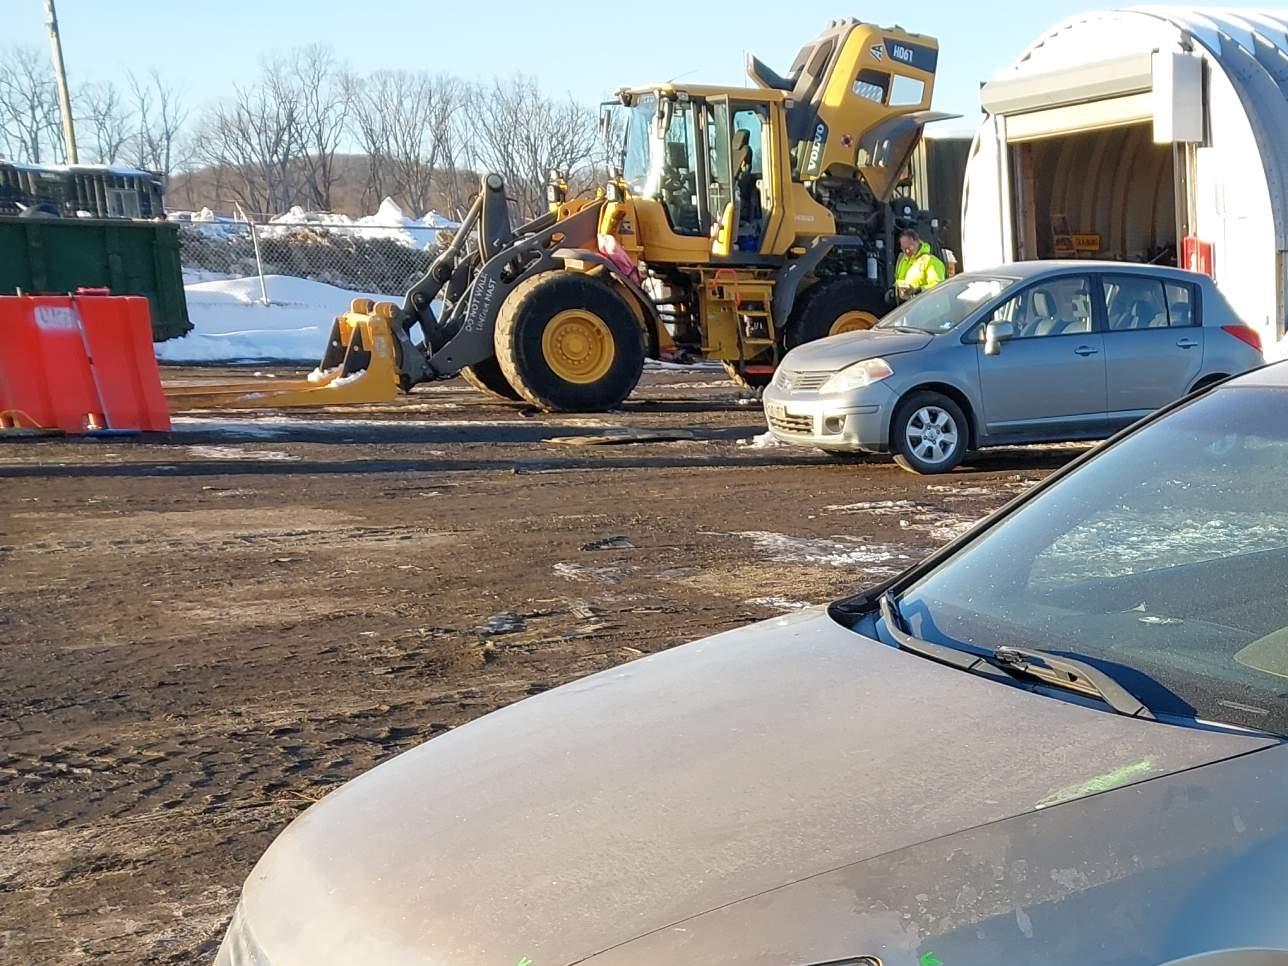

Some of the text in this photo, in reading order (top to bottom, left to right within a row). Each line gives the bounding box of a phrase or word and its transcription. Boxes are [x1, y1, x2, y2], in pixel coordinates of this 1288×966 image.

[807, 123, 825, 171] VOLVO
[484, 277, 497, 302] MAST
[465, 318, 474, 332] DO
[470, 297, 480, 318] NOT
